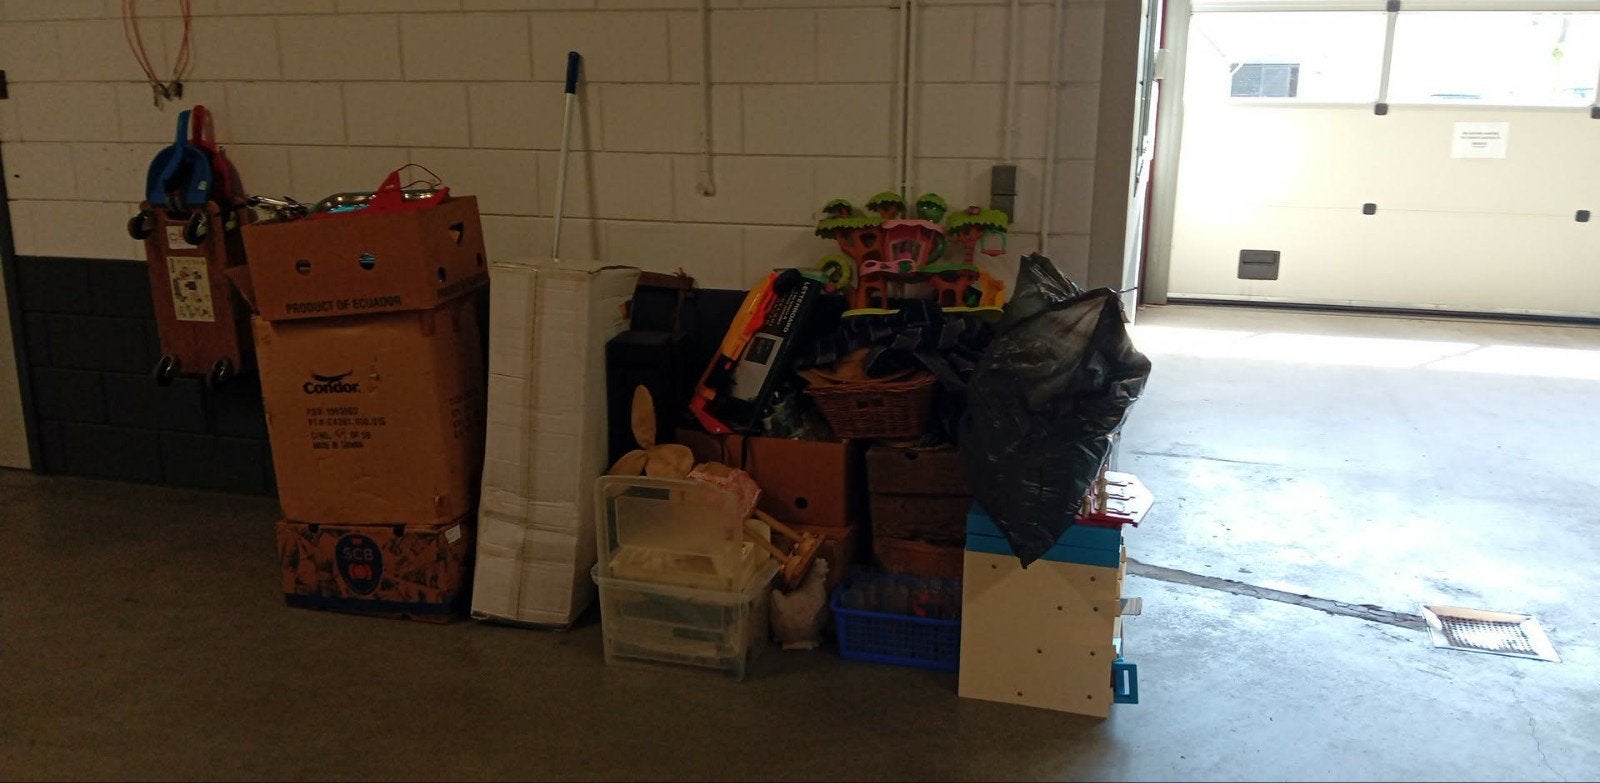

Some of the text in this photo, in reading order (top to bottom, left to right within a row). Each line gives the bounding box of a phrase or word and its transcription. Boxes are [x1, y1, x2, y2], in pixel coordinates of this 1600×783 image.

[286, 295, 402, 314] PRODUCT OF ECUADOR
[303, 381, 360, 394] Condor
[343, 546, 374, 561] SCB
